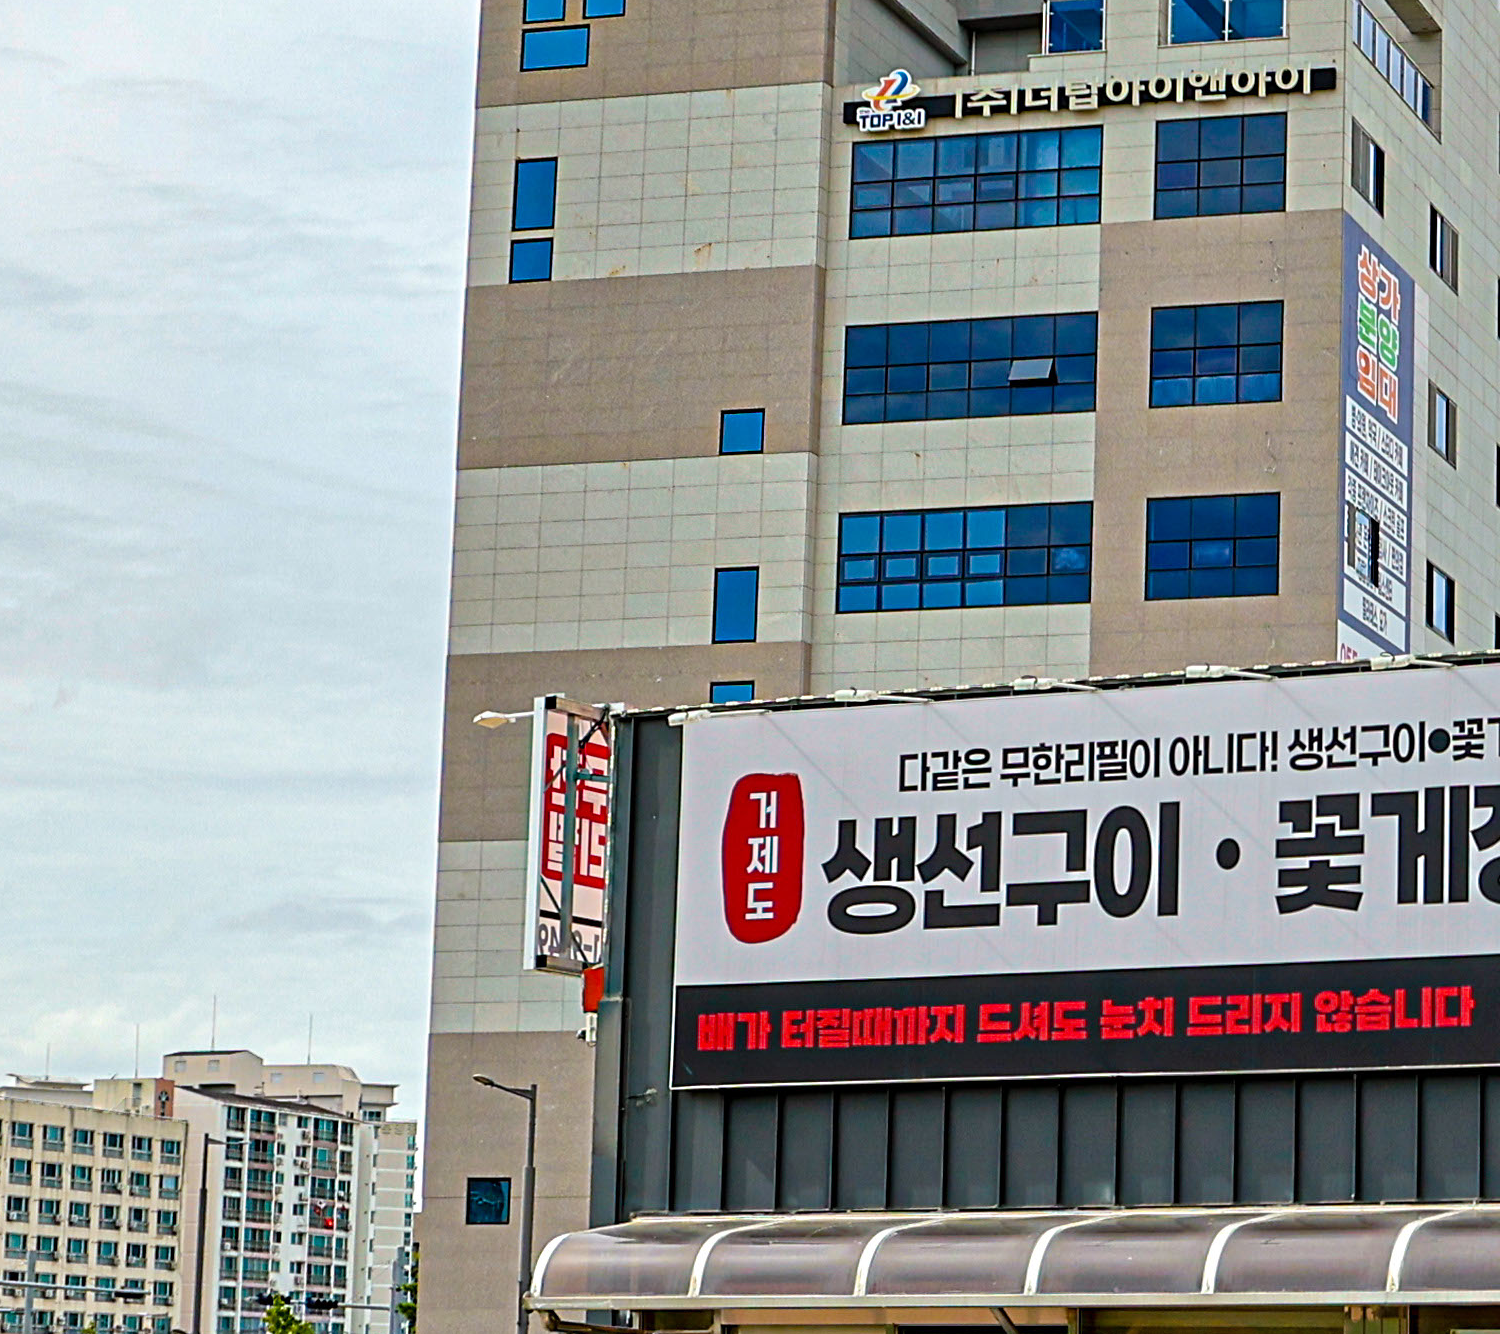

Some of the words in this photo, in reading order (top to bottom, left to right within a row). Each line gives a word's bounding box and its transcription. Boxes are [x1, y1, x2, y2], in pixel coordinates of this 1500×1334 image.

[1358, 244, 1401, 326] 상가
[1358, 292, 1400, 371] 분양
[1357, 345, 1399, 424] 임대
[898, 741, 994, 795] 다같은
[999, 730, 1162, 788] 무한리필이
[1168, 726, 1279, 779] 아니다!
[746, 787, 781, 924] 거제도
[821, 799, 1181, 937] 생선구이
[975, 995, 1088, 1044] 드셔도
[1099, 991, 1175, 1041] 눈치
[1185, 988, 1306, 1038] 드리지
[1314, 982, 1477, 1035] 않습니다
